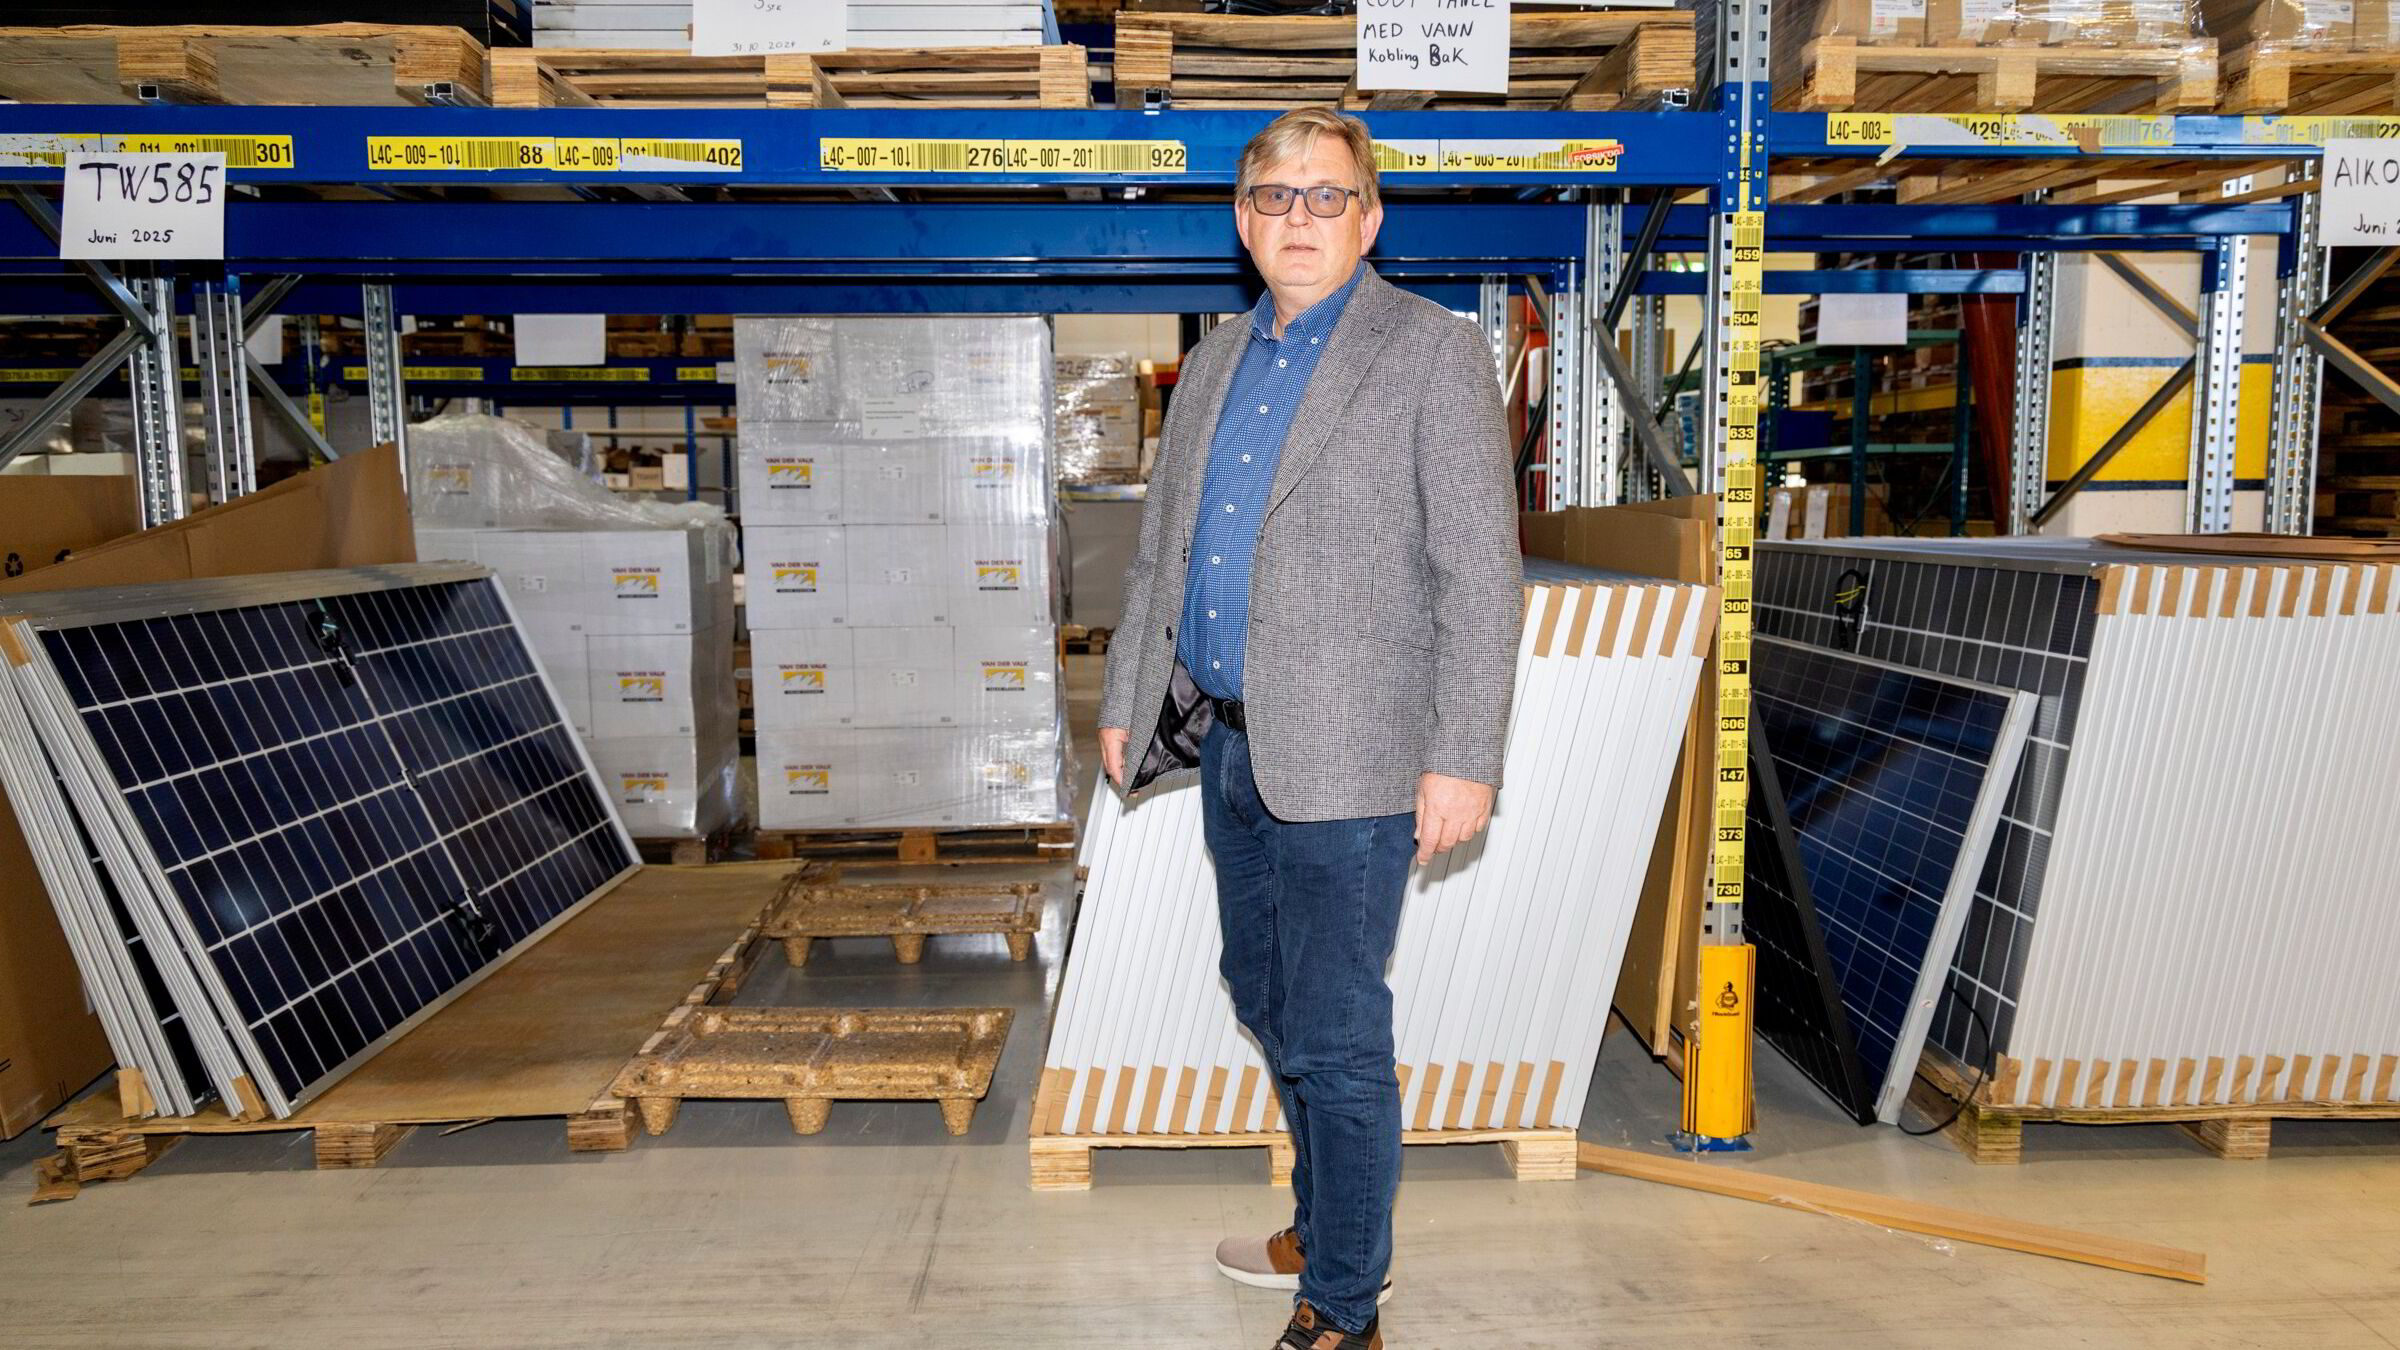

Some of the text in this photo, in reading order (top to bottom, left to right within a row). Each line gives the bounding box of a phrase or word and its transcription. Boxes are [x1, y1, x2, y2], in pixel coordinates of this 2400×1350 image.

[1363, 21, 1474, 39] MED VANN
[1369, 48, 1419, 70] Kobling
[256, 143, 292, 163] 301
[370, 144, 543, 165] L4C-009-10 88
[706, 147, 741, 166] 402
[968, 148, 1003, 167] 276
[1007, 147, 1186, 168] L4C-007-20 922
[2334, 156, 2400, 187] AIKO
[79, 162, 219, 204] TW585
[2353, 213, 2388, 235] Juni
[88, 229, 174, 244] Juni 2025
[1735, 248, 1760, 261] 459
[1733, 312, 1758, 325] 504
[1729, 427, 1754, 439] 633
[1728, 489, 1752, 501] 435
[1726, 548, 1742, 559] 65
[1724, 601, 1749, 612] 300
[1723, 662, 1740, 673] 68
[1721, 718, 1745, 730] 606
[1721, 769, 1744, 781] 147
[1718, 828, 1743, 840] 373
[1717, 884, 1741, 895] 730
